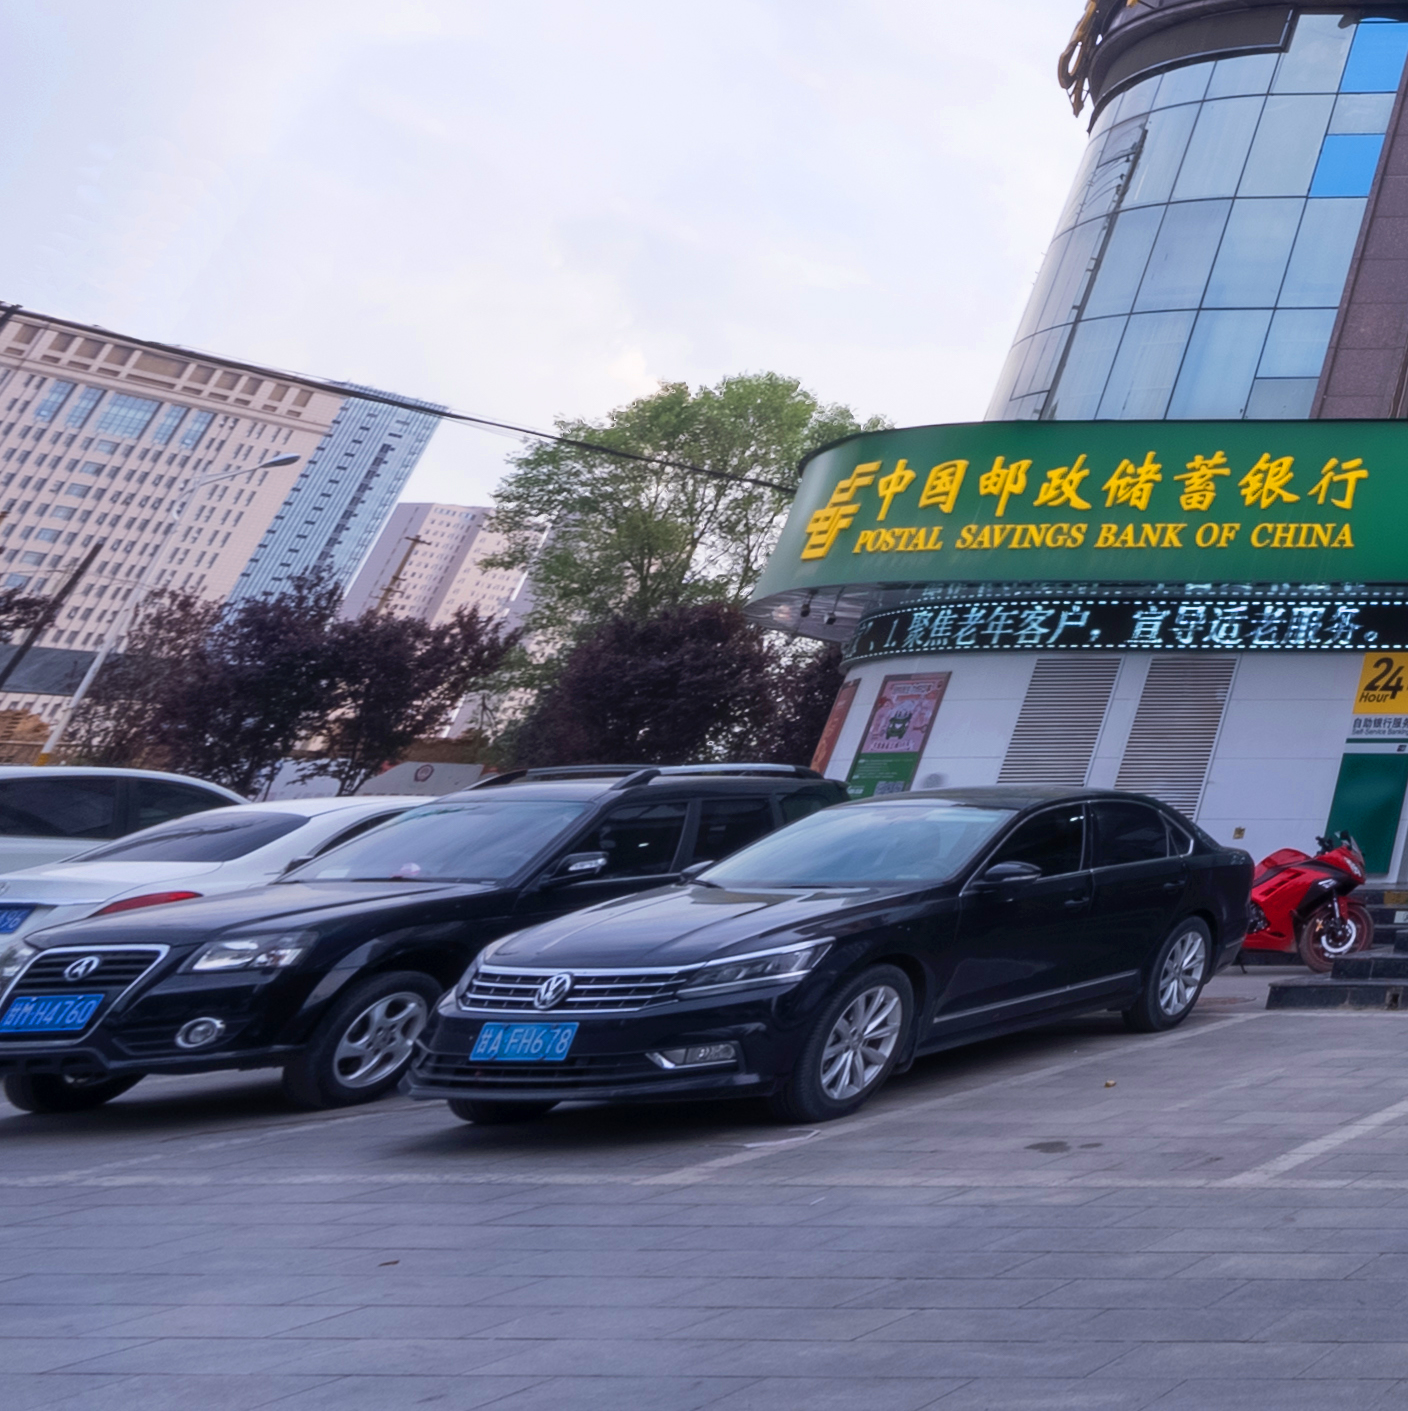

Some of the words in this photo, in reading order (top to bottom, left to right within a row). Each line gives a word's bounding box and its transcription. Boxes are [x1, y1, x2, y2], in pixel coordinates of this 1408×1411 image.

[877, 451, 1369, 521] 中国邮政储蓄银行
[852, 526, 943, 554] POSTAL
[955, 523, 1088, 549] SAVINGS
[1094, 523, 1187, 548] BANK
[1195, 523, 1240, 548] OF
[1250, 523, 1355, 548] CHINA
[1363, 657, 1405, 699] 24
[1359, 692, 1390, 703] Hour
